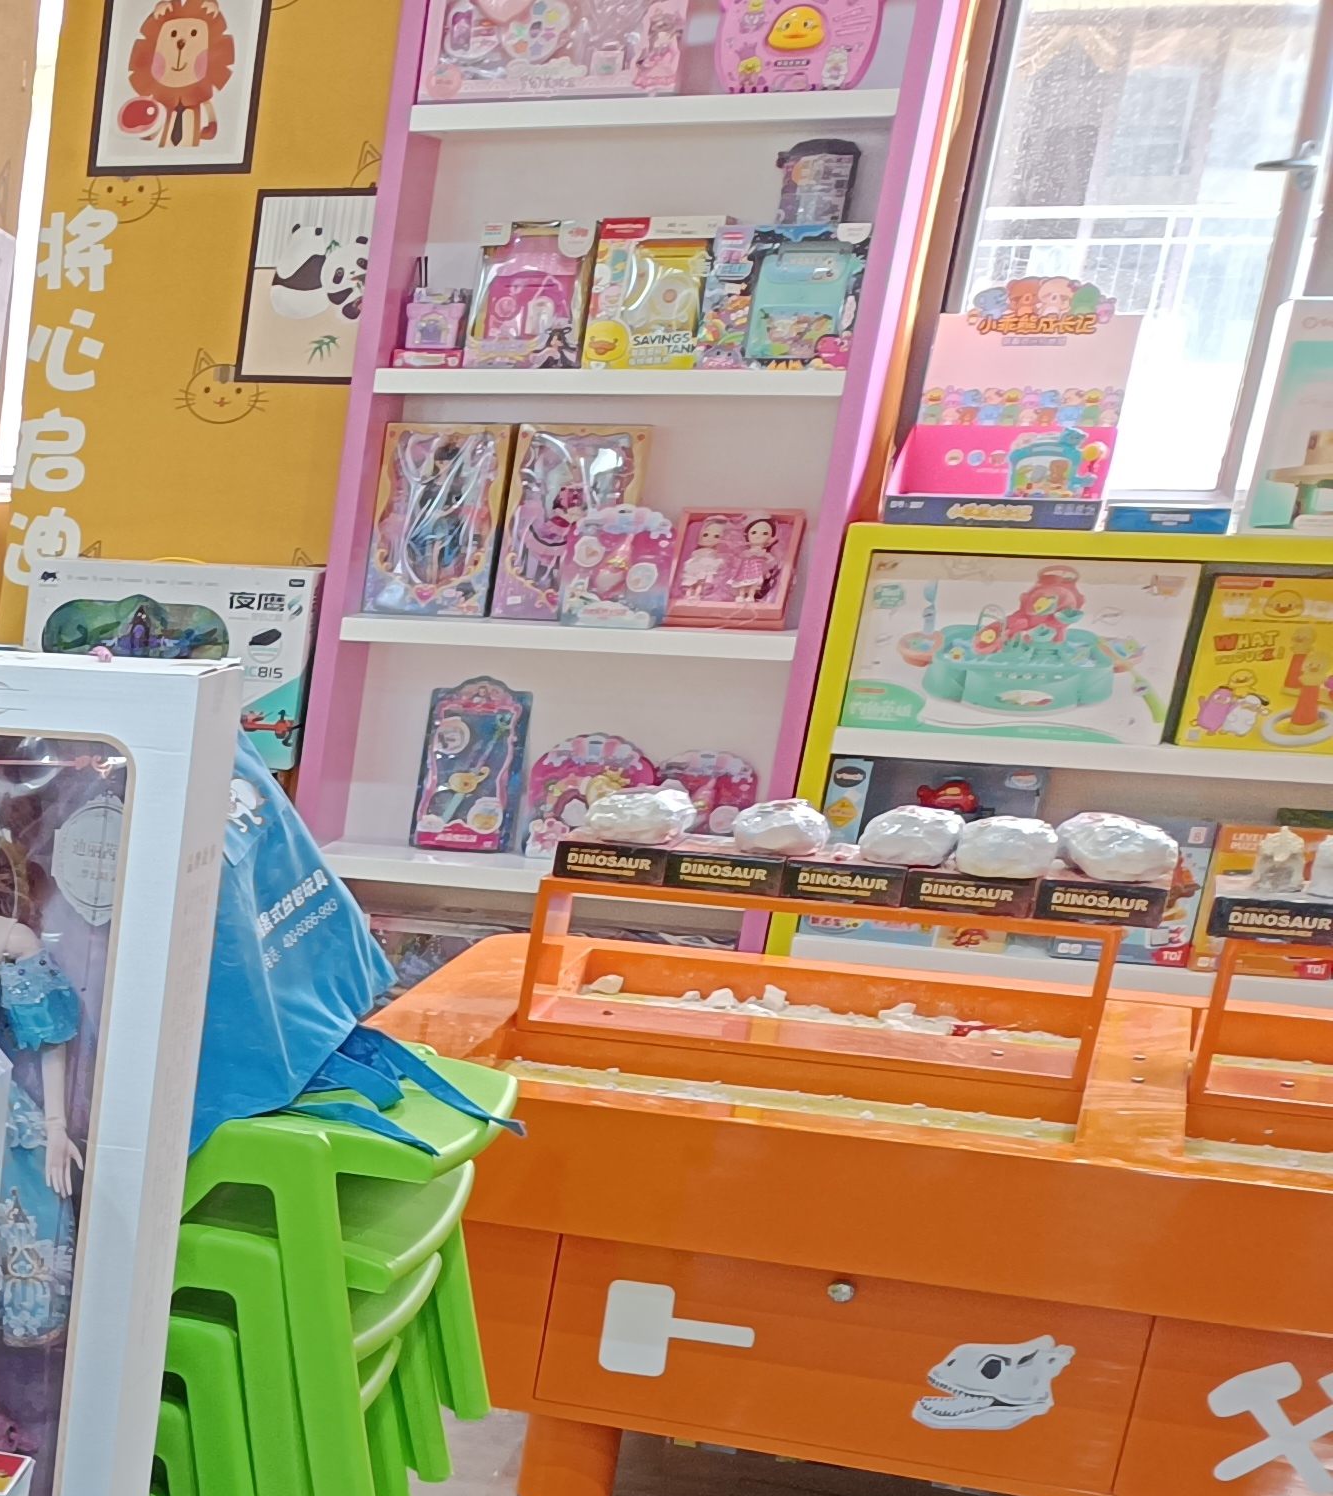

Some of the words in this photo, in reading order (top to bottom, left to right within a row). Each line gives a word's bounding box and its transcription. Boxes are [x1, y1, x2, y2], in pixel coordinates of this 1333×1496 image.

[633, 334, 690, 345] SAVINGS
[229, 592, 286, 613] 夜鹰
[1214, 630, 1281, 651] WHAT
[567, 851, 652, 872] DINOSAUR
[680, 861, 768, 882] DINOSAUR
[797, 870, 888, 892] DINOSAUR
[919, 881, 1014, 902] DINOSAUR
[1051, 891, 1149, 912] DINOSAUR
[1227, 910, 1333, 932] DINOSAUR
